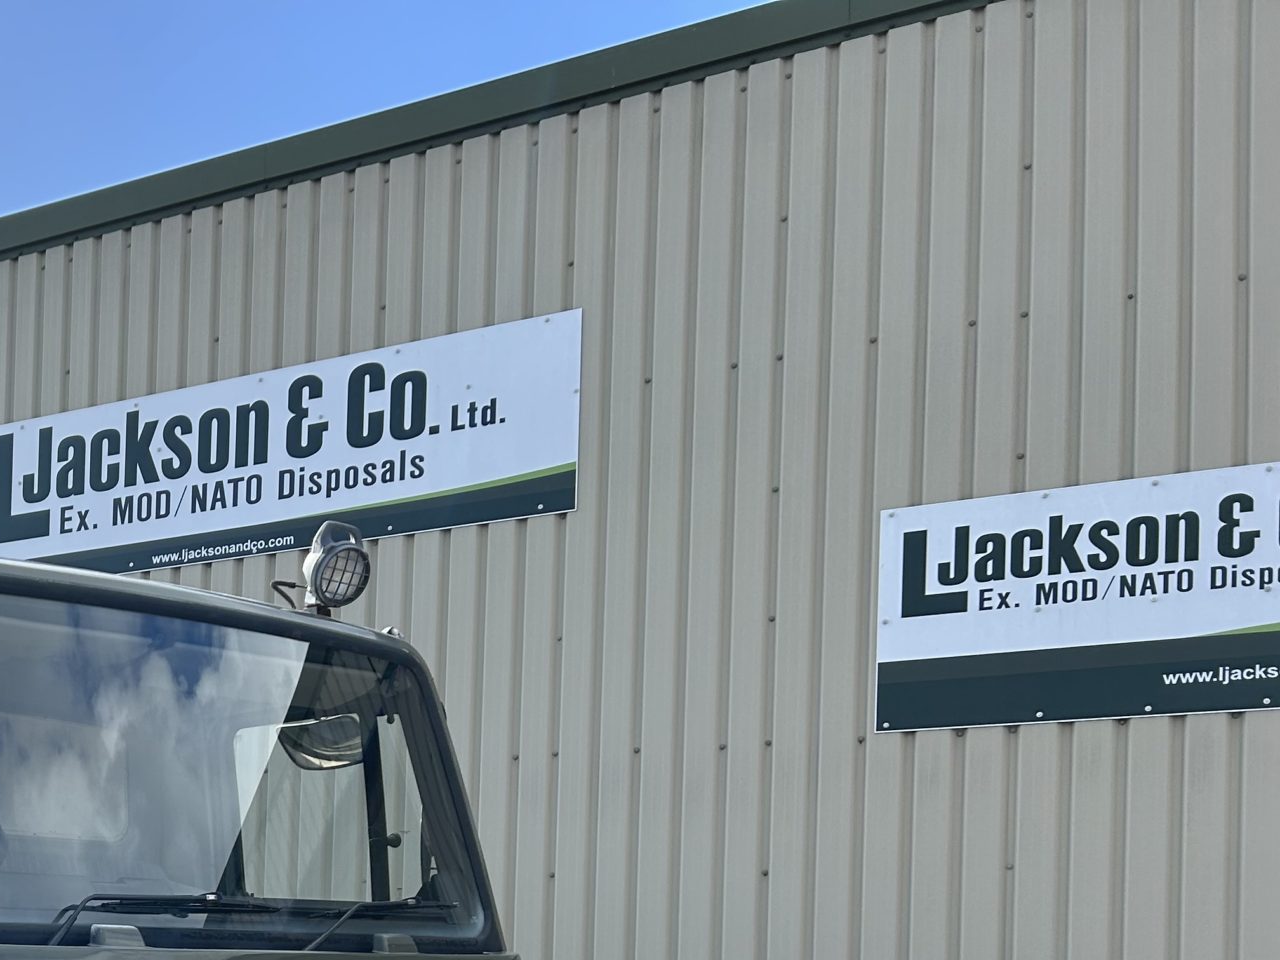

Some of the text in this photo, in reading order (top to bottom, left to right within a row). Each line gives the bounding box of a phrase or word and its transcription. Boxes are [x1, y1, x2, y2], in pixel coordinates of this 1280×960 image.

[285, 374, 329, 459] &
[346, 362, 440, 449] Co.
[451, 397, 506, 432] Ltd.
[59, 450, 425, 535] Ex. MOD/NATO Disposals
[1217, 493, 1261, 559] &
[978, 564, 1280, 611] Ex. MOD/NATO Disp
[1162, 664, 1280, 685] www.ljacks
